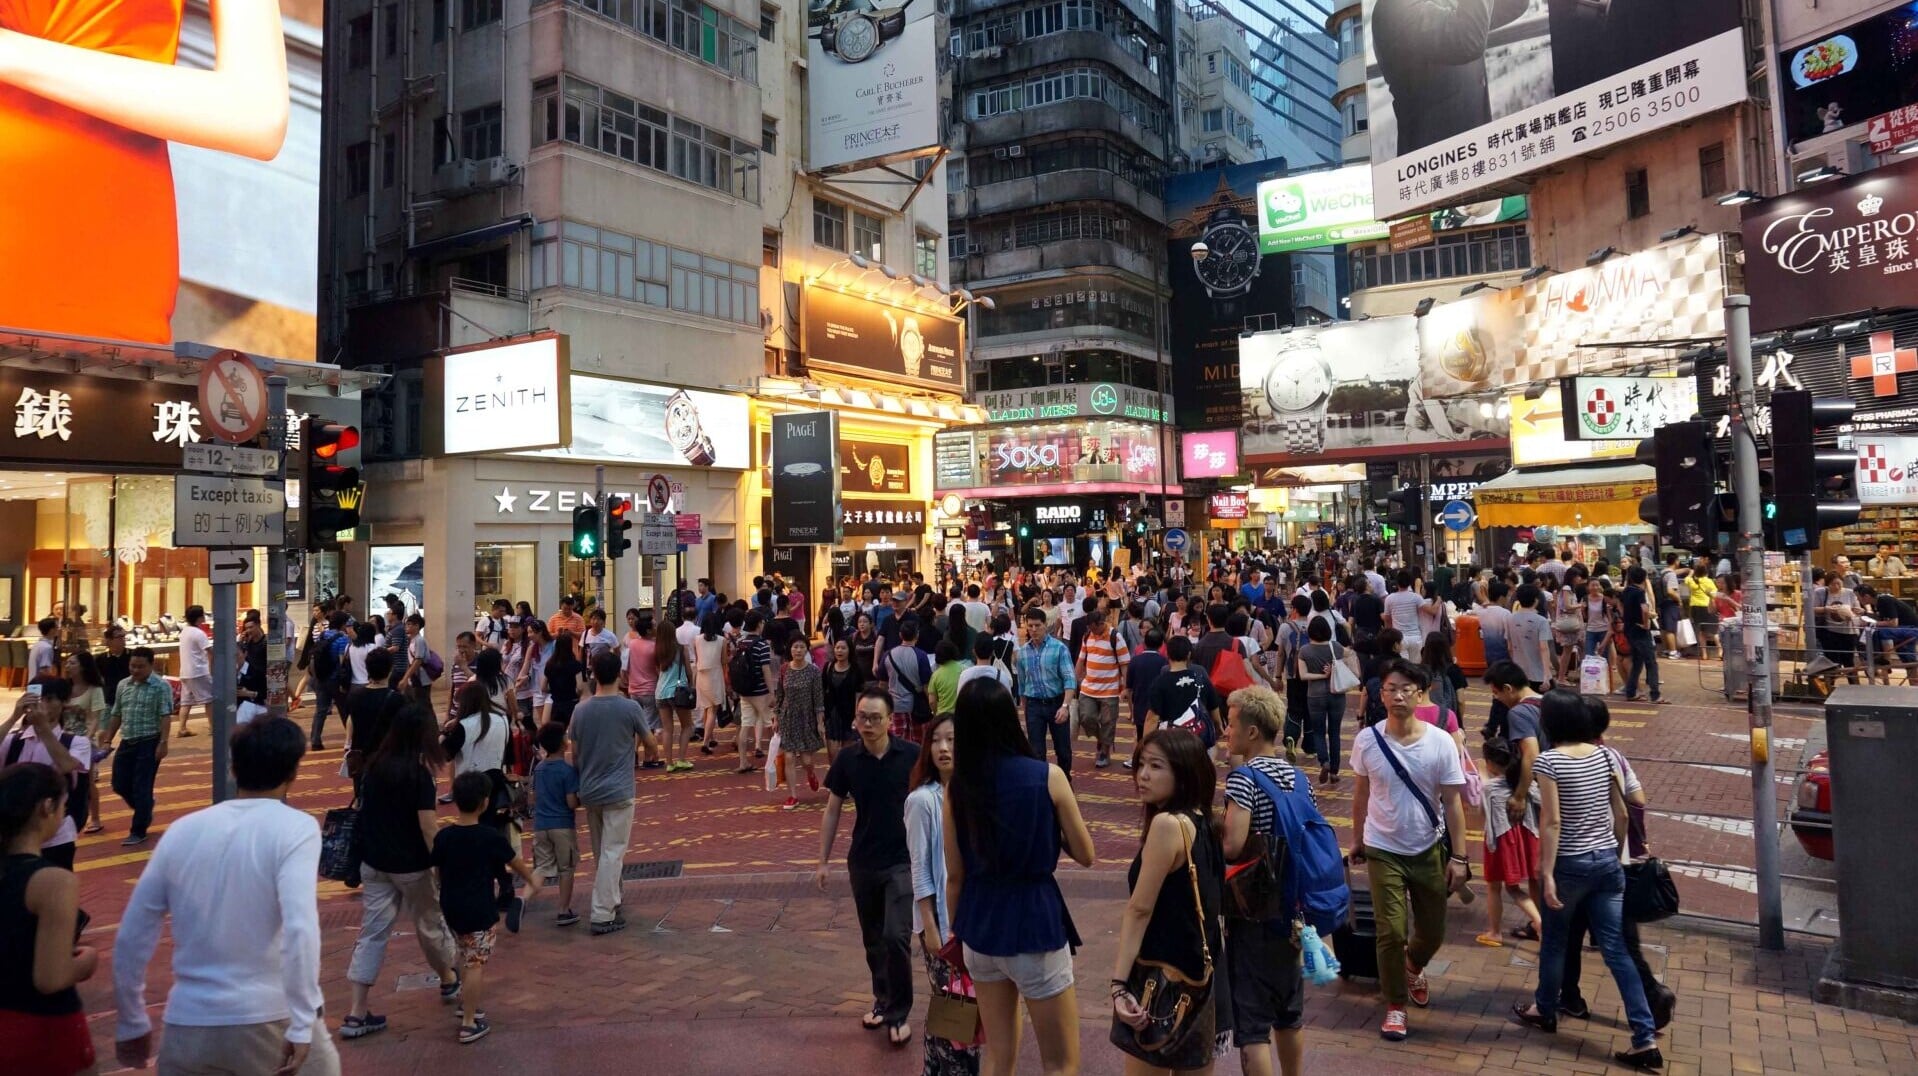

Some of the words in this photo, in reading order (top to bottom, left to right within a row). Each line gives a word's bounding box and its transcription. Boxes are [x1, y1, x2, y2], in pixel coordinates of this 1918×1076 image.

[1592, 106, 1641, 136] 2506
[1647, 86, 1701, 119] 3500
[1397, 142, 1478, 183] LONGINES
[1487, 101, 1588, 150] 時代廣場旗艦店
[1598, 58, 1701, 110] 現已隆重開幕
[1762, 207, 1918, 274] EMPERO
[1883, 259, 1913, 274] since
[1545, 267, 1664, 318] HONMA
[456, 386, 546, 412] ZENITH
[1040, 404, 1078, 418] MESS
[1151, 409, 1168, 422] MES
[1875, 408, 1918, 420] PHARMAC
[786, 421, 817, 439] PIAGET
[262, 454, 275, 469] 12
[191, 485, 239, 506] Except
[242, 488, 273, 504] taxis
[528, 491, 651, 512] ZENTH
[1212, 495, 1229, 507] Nail
[1230, 495, 1246, 507] Box
[1036, 506, 1081, 520] RADO
[194, 512, 270, 534] 的士例外
[773, 548, 793, 562] PIAGET
